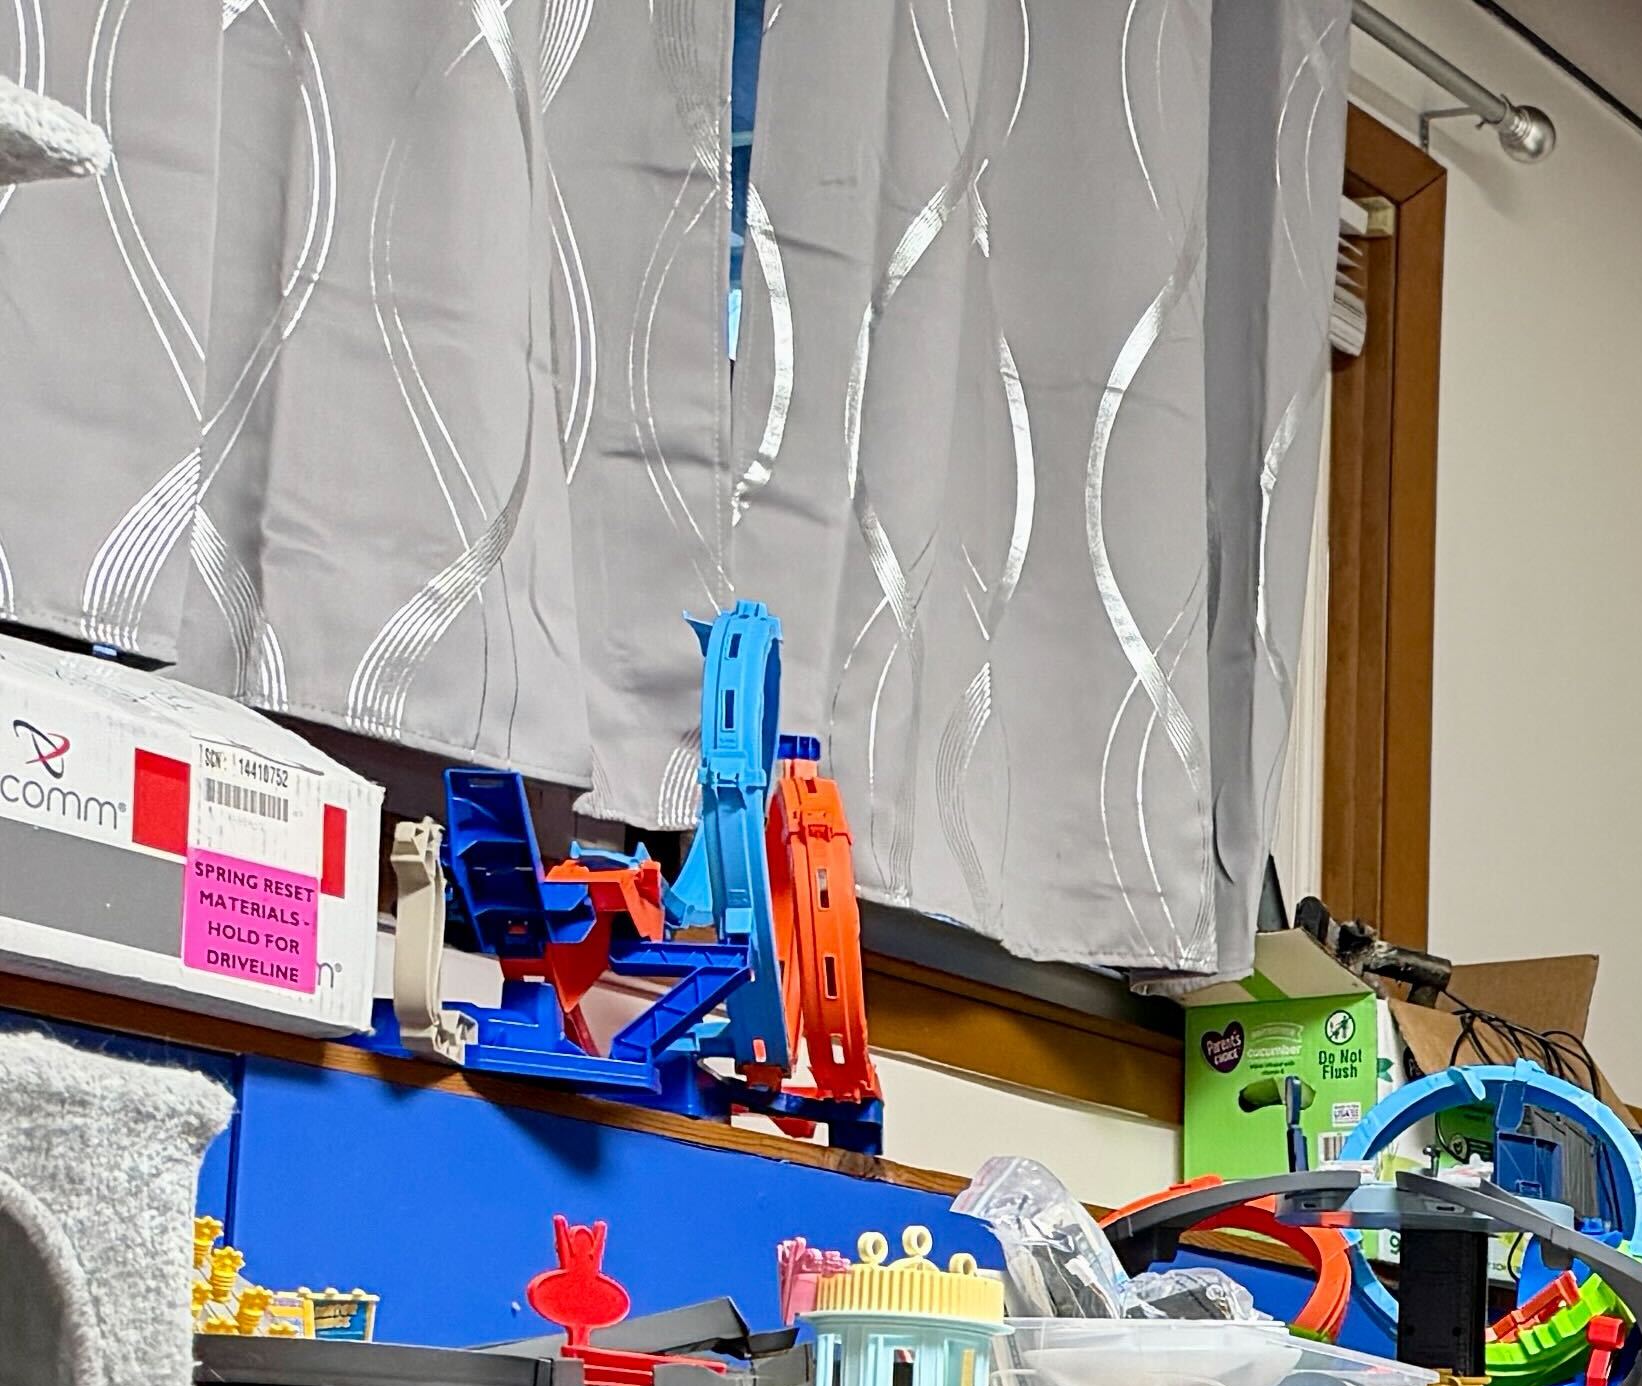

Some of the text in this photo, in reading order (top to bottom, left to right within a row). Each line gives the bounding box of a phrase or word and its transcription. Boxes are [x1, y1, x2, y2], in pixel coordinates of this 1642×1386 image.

[239, 757, 289, 789] 14410752
[194, 861, 315, 903] SPRING RESET
[199, 890, 300, 927] MATERIALS
[207, 920, 300, 955] HOLD FOR
[206, 949, 300, 983] DRIVELINE
[1318, 1048, 1362, 1066] Do Not
[1322, 1063, 1358, 1080] Flush
